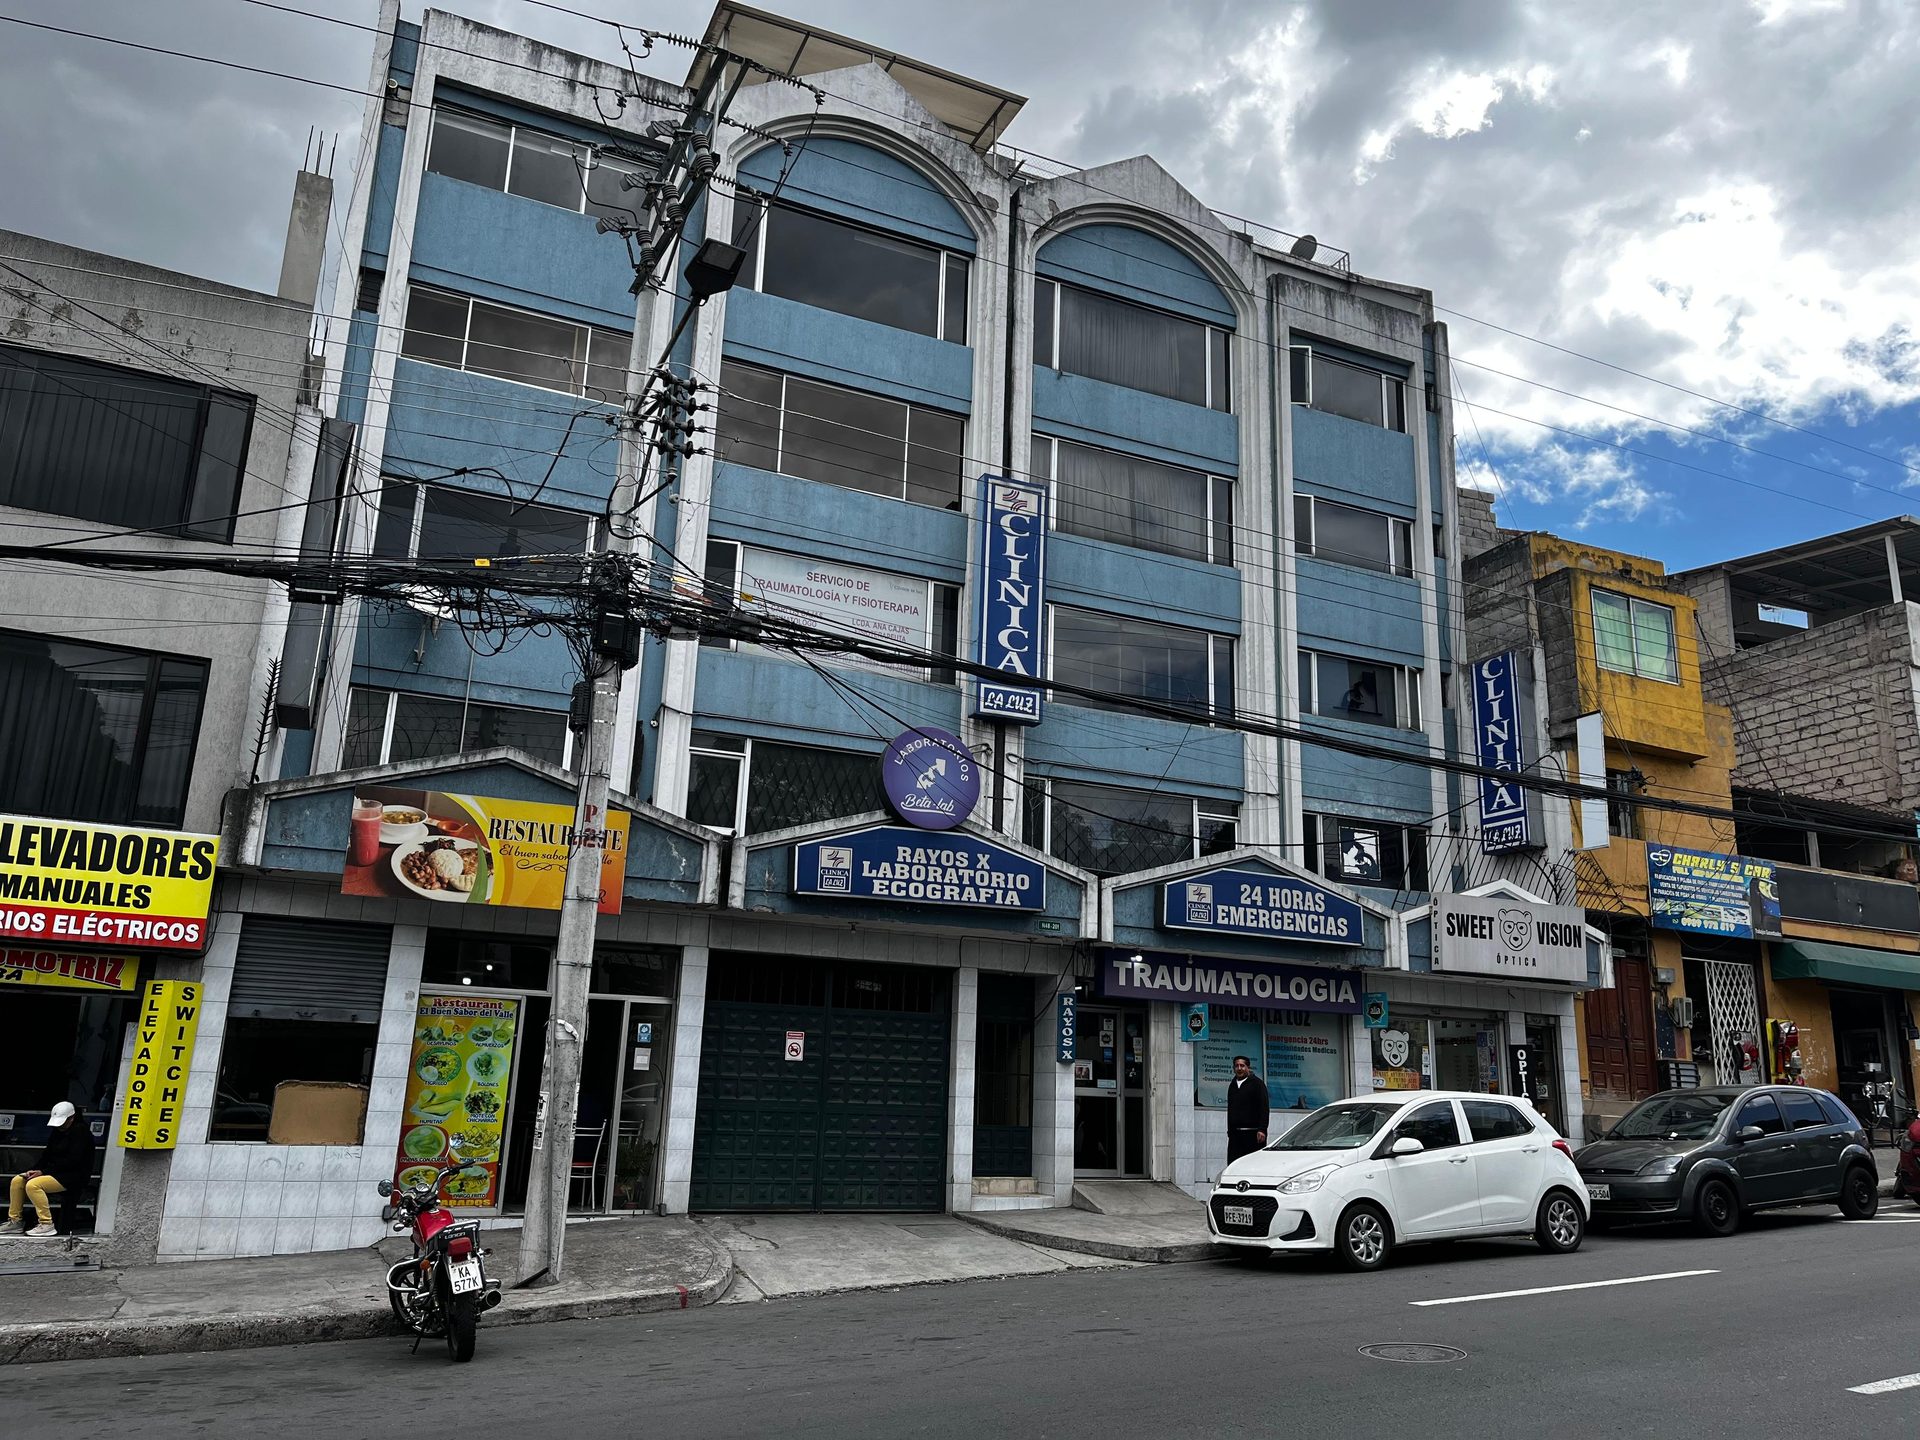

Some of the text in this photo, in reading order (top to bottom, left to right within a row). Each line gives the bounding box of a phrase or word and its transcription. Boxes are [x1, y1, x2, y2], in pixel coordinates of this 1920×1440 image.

[806, 571, 870, 591] SERVICIO DE
[844, 594, 850, 604] Y
[852, 595, 919, 616] FISIOTERAPIA
[996, 513, 1033, 676] CLINICA
[873, 621, 887, 630] ANA
[888, 623, 911, 635] CAJAS
[985, 691, 1033, 714] LA LUZ
[894, 737, 969, 782] LABORATORIOS
[500, 844, 514, 856] El
[514, 848, 539, 859] buen
[542, 850, 569, 861] sabor
[896, 846, 990, 869] RAYOS X
[820, 868, 849, 877] CLINICA
[862, 860, 1030, 890] LABORATORIO
[1744, 864, 1772, 880] CAR
[0, 873, 152, 909] MANUALES
[872, 879, 1021, 906] ECOGRAFIA
[1240, 884, 1325, 913] 24 HORAS
[1188, 903, 1211, 911] CLINICA
[52, 913, 200, 942] ELÉCTRICOS
[1217, 905, 1348, 937] EMERGENCIAS
[1446, 912, 1582, 948] SWEET VISION
[0, 949, 125, 989] MOTRIZ
[1496, 954, 1537, 967] ÓPTICA
[1113, 960, 1356, 1003] TRAUMATOLOGIA
[420, 1007, 428, 1015] El
[453, 1009, 478, 1017] Sabor
[494, 1010, 513, 1019] Valle
[433, 998, 504, 1009] Restaurant
[1062, 996, 1074, 1060] RAYOS X
[1266, 1034, 1329, 1046] Emergencia 24hrs
[124, 983, 164, 1144] ELEVADORES
[155, 986, 195, 1143] SWITCHES
[458, 1266, 471, 1278] KA
[454, 1276, 478, 1292] 577K
